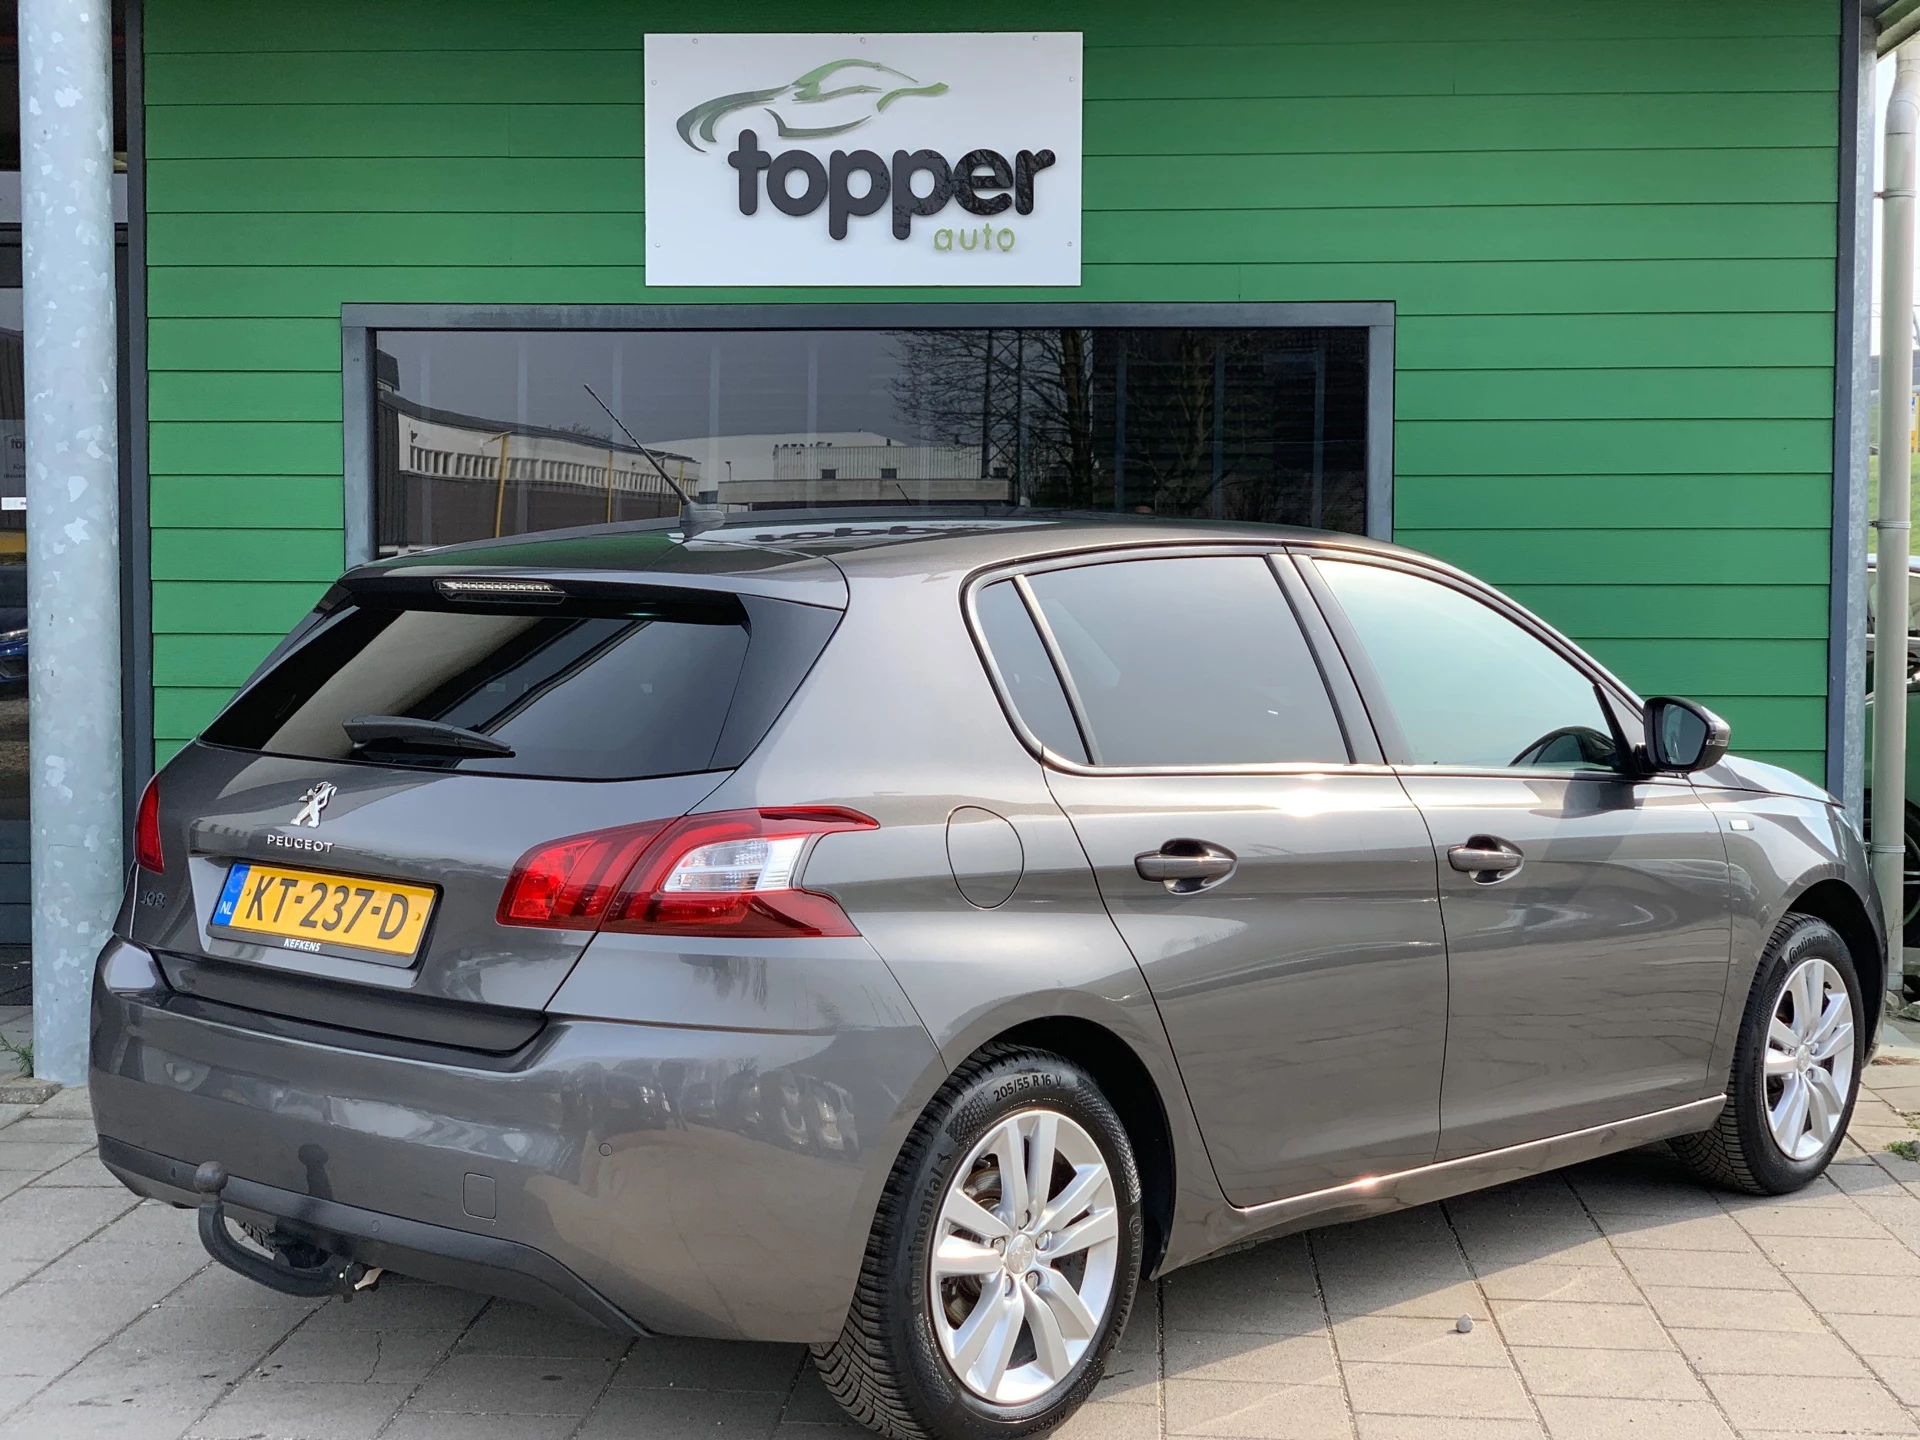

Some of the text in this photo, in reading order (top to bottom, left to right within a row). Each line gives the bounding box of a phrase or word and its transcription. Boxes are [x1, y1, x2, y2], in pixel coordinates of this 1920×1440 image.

[727, 129, 1056, 240] topper
[933, 222, 1016, 251] auto
[266, 834, 334, 853] PEUGEOT
[219, 900, 232, 915] NL
[245, 875, 410, 941] KT-237-D
[283, 938, 322, 952] NEFKENS
[993, 1076, 1030, 1102] 205/55
[1032, 1075, 1040, 1087] R
[1041, 1074, 1052, 1087] 16
